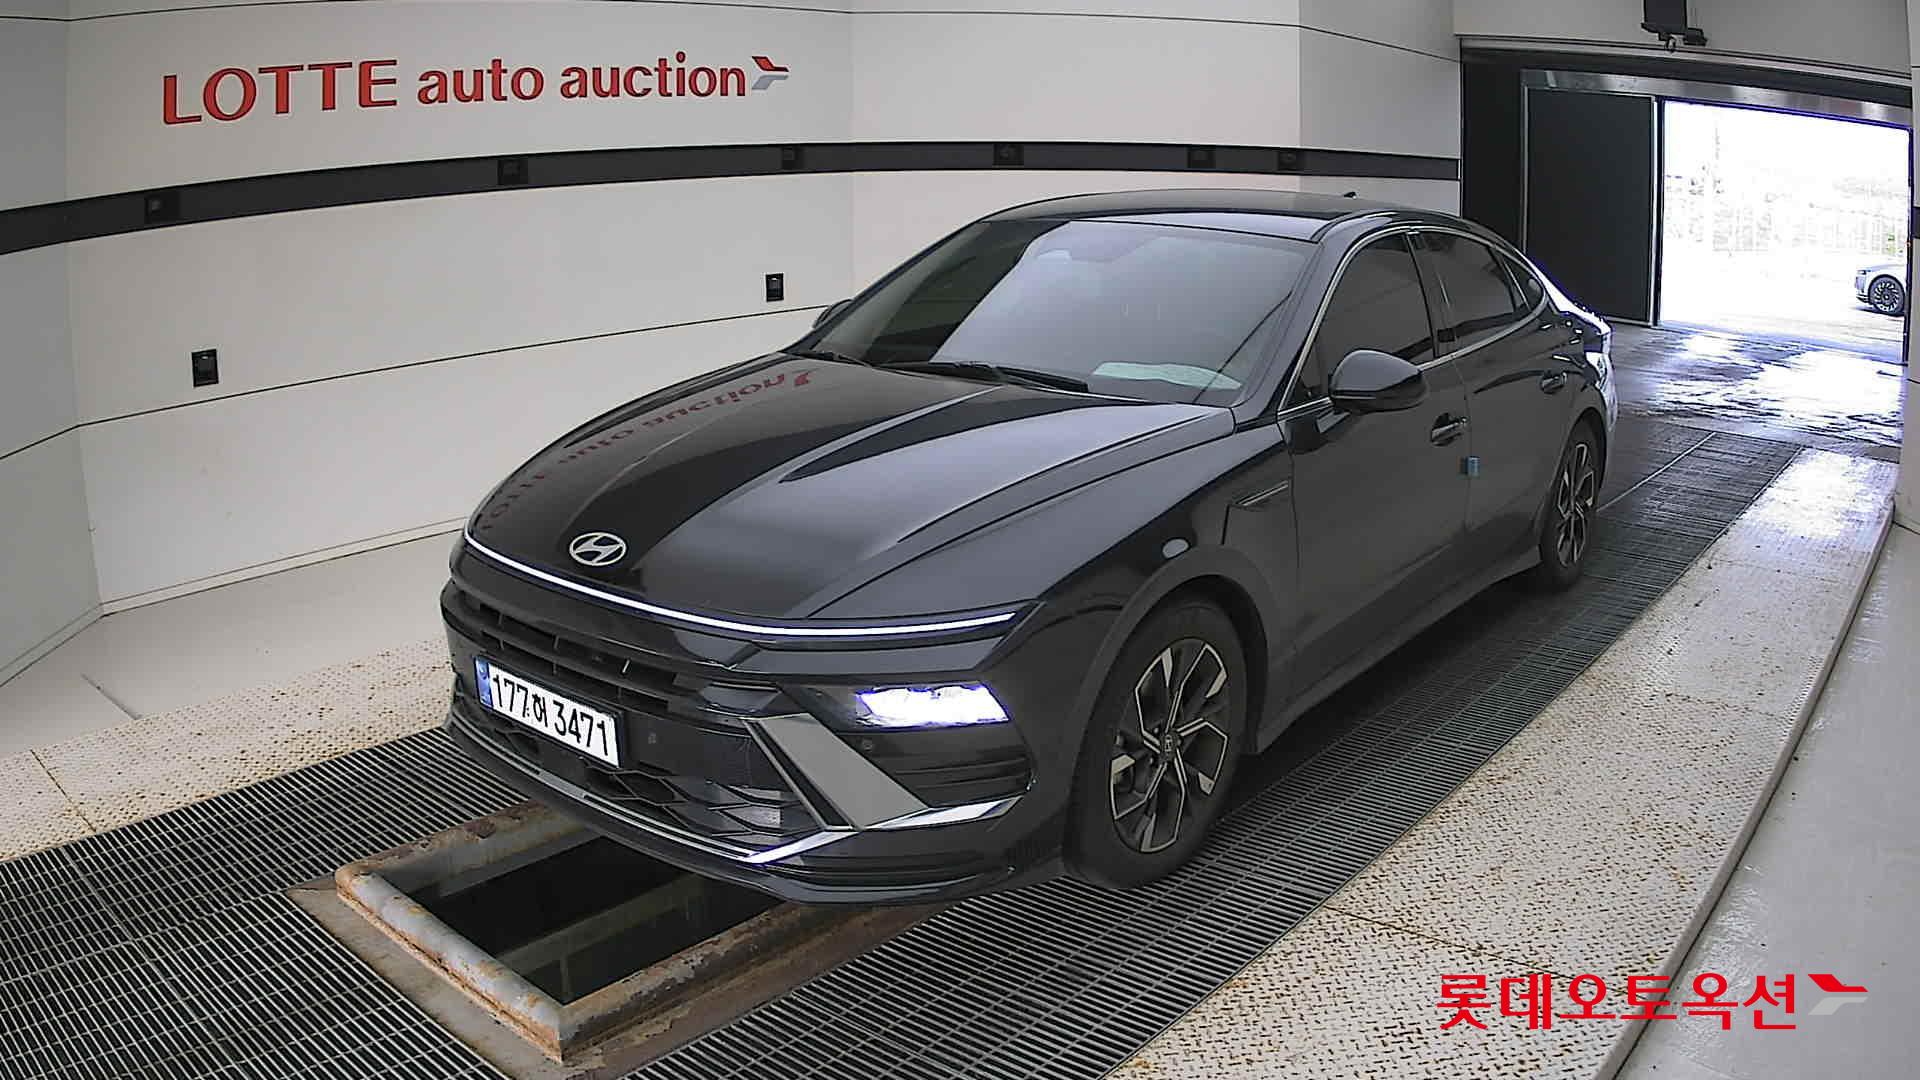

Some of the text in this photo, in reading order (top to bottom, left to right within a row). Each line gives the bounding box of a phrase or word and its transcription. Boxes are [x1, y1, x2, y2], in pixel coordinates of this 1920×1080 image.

[162, 51, 747, 126] LOTTE auto auction
[553, 699, 609, 757] 3471
